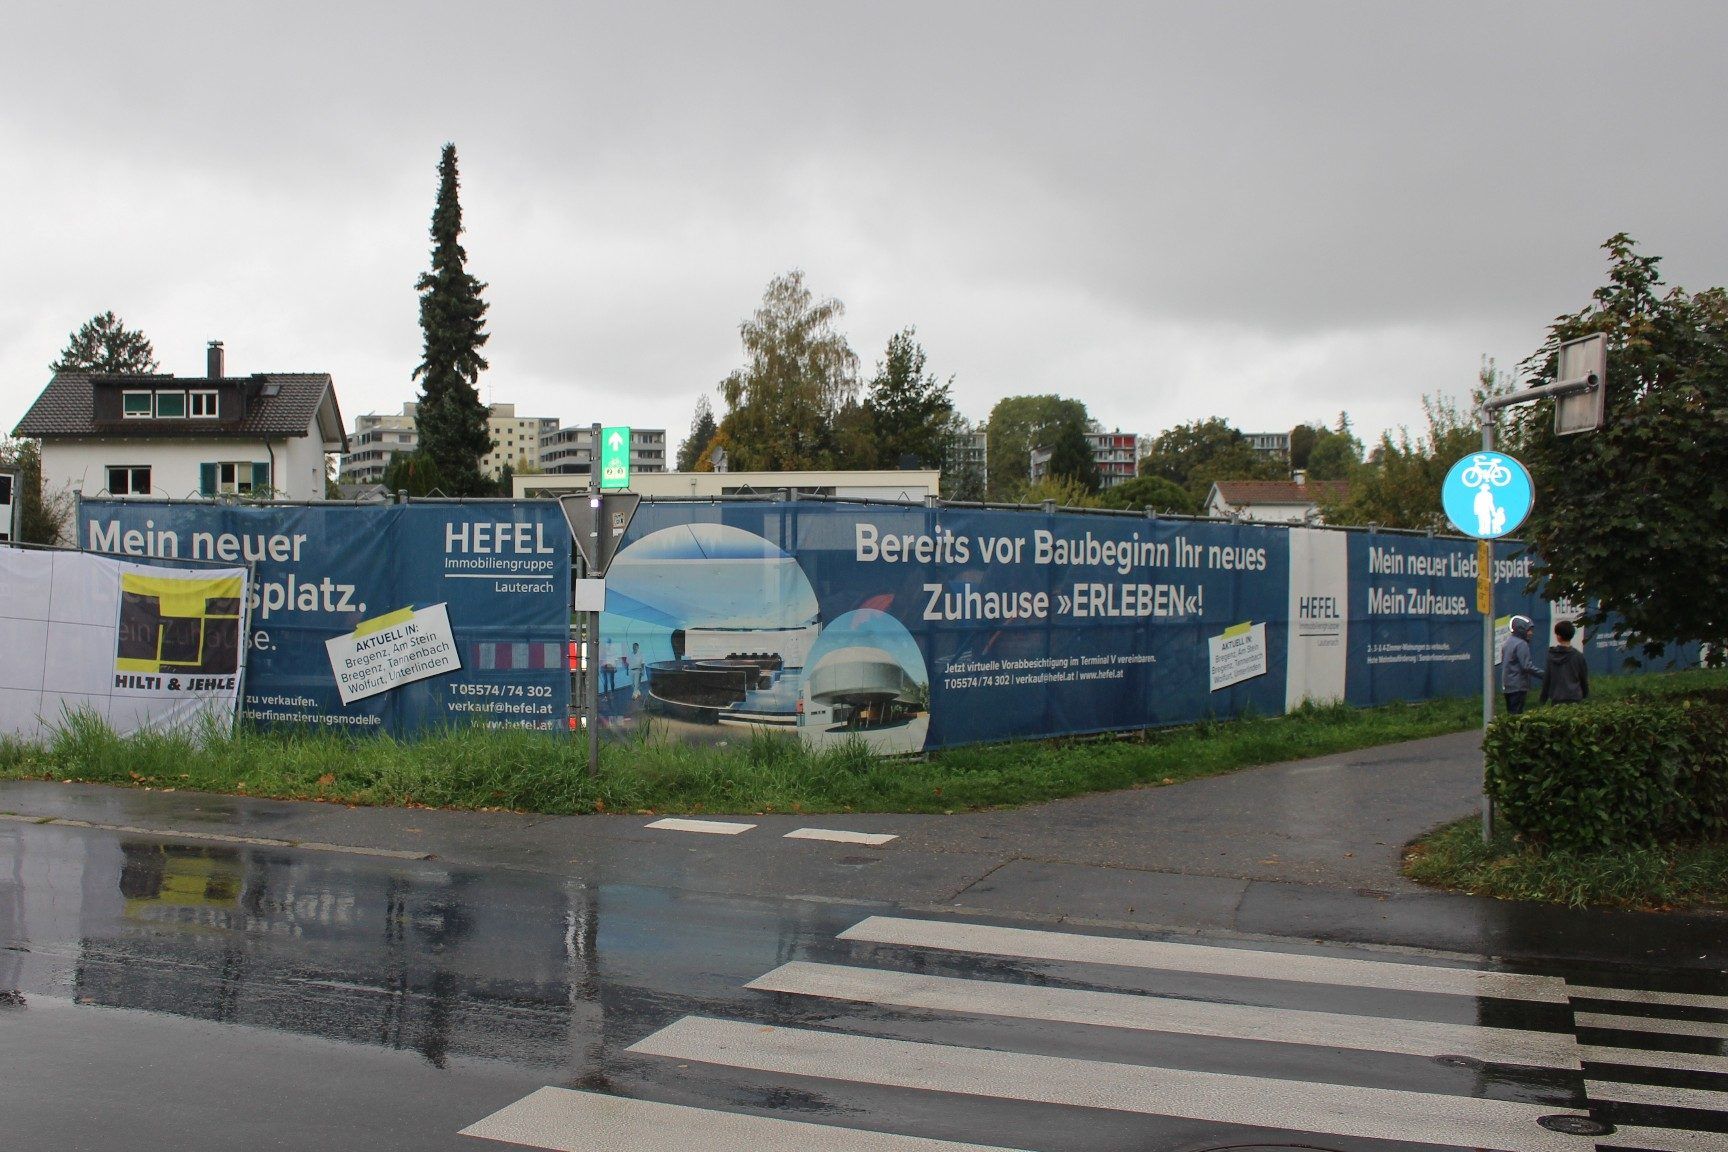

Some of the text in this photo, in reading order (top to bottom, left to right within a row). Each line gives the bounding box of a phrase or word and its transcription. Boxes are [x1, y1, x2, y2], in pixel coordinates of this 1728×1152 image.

[89, 520, 307, 562] Mein neuer
[445, 523, 554, 553] HEFEL
[855, 523, 1267, 575] Bereits vor Baubeginn Ihr neues
[445, 557, 554, 572] Immobiliengruppe
[1369, 546, 1404, 574] Mein
[1407, 555, 1448, 577] neuer
[495, 581, 554, 593] Lauterach
[1368, 587, 1405, 614] Mein
[1407, 588, 1469, 615] Zuhause.
[923, 583, 1049, 621] Zuhause
[1300, 596, 1340, 619] HEFEL
[345, 632, 437, 669] Bregenz, Am Stein
[356, 624, 419, 652] AKTUELL IN:
[341, 642, 450, 683] Bregenz, Tannenbach
[348, 656, 449, 694] Wolfurt, Unterlinden
[944, 654, 1157, 674] Jetzt virtuelle Vorabbesichtigung im Terminal V vereinbaren.
[115, 674, 236, 691] HILTI & JEHLE
[527, 685, 552, 697] 302
[994, 675, 1010, 686] 302
[1080, 669, 1124, 680] www.hefel.at
[246, 694, 318, 707] zu verkaufen.
[447, 701, 553, 714] verkauf@hefel.at
